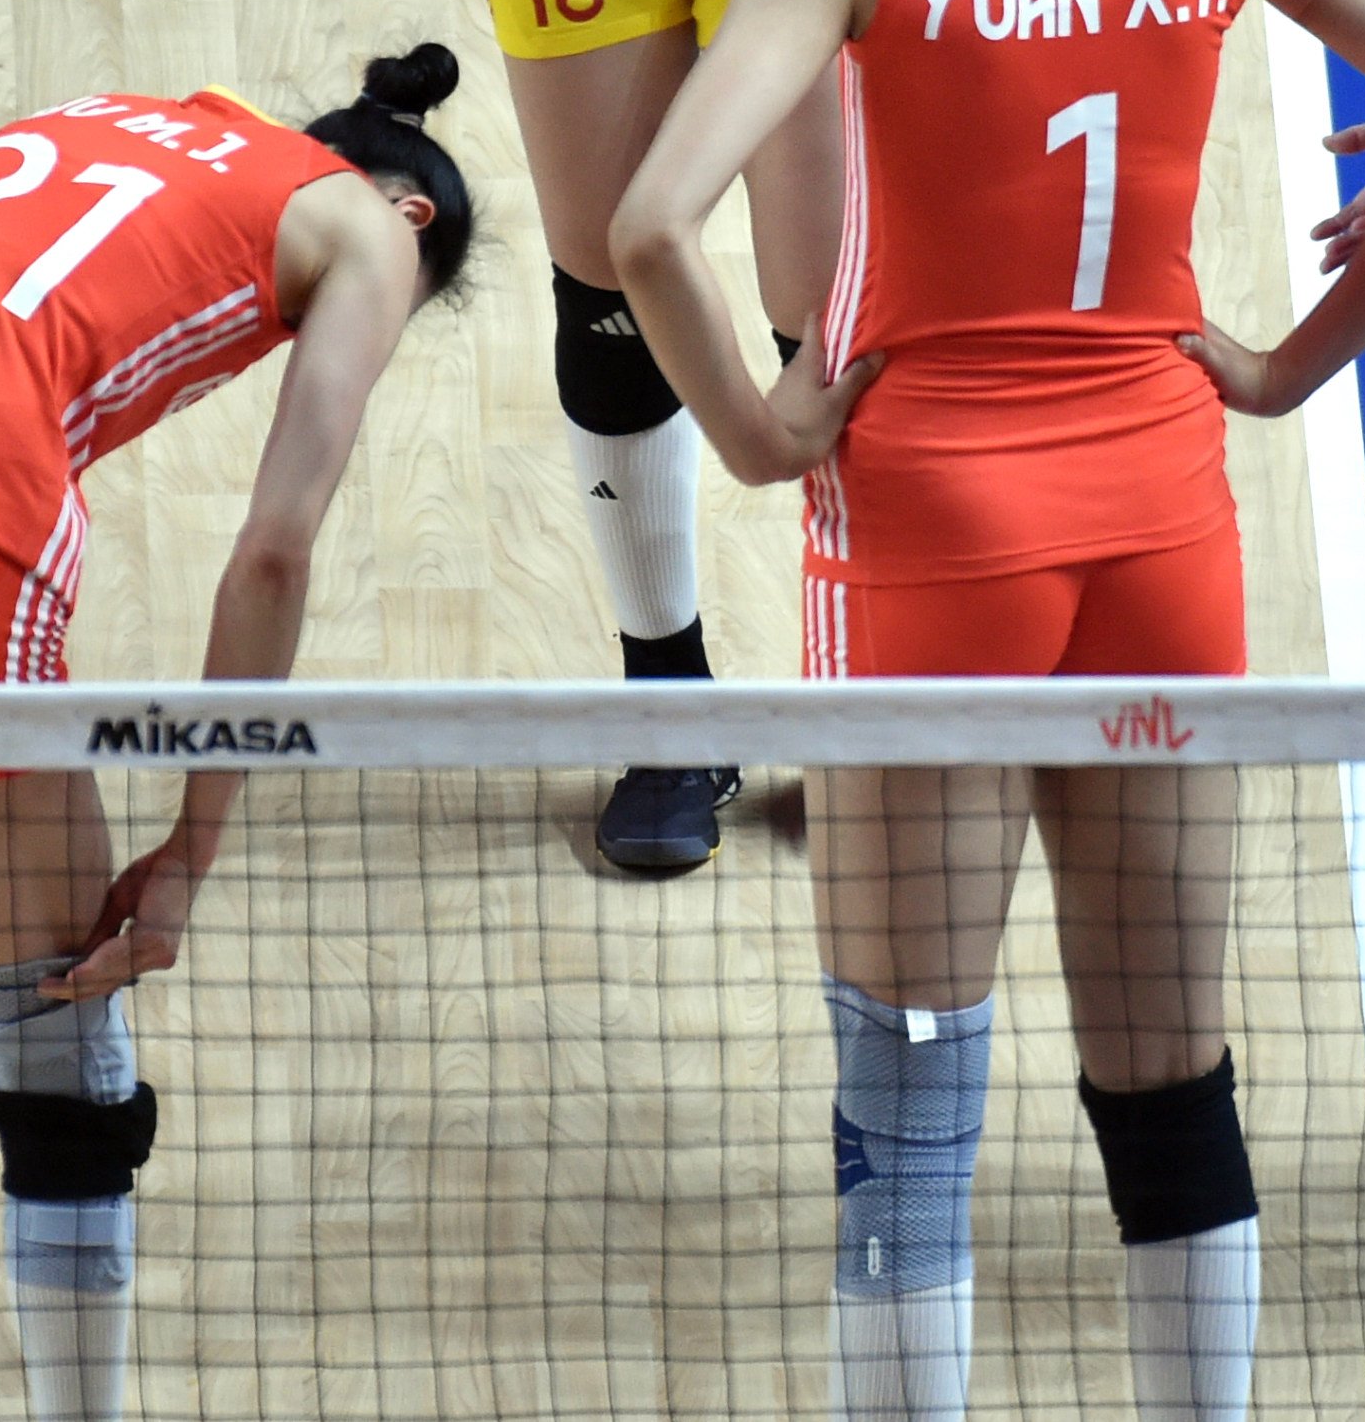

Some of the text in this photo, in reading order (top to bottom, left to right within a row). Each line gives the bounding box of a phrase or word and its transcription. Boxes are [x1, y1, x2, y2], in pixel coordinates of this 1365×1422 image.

[1046, 91, 1118, 312] 1
[87, 700, 318, 755] MIKASA
[1099, 694, 1194, 752] VNL
